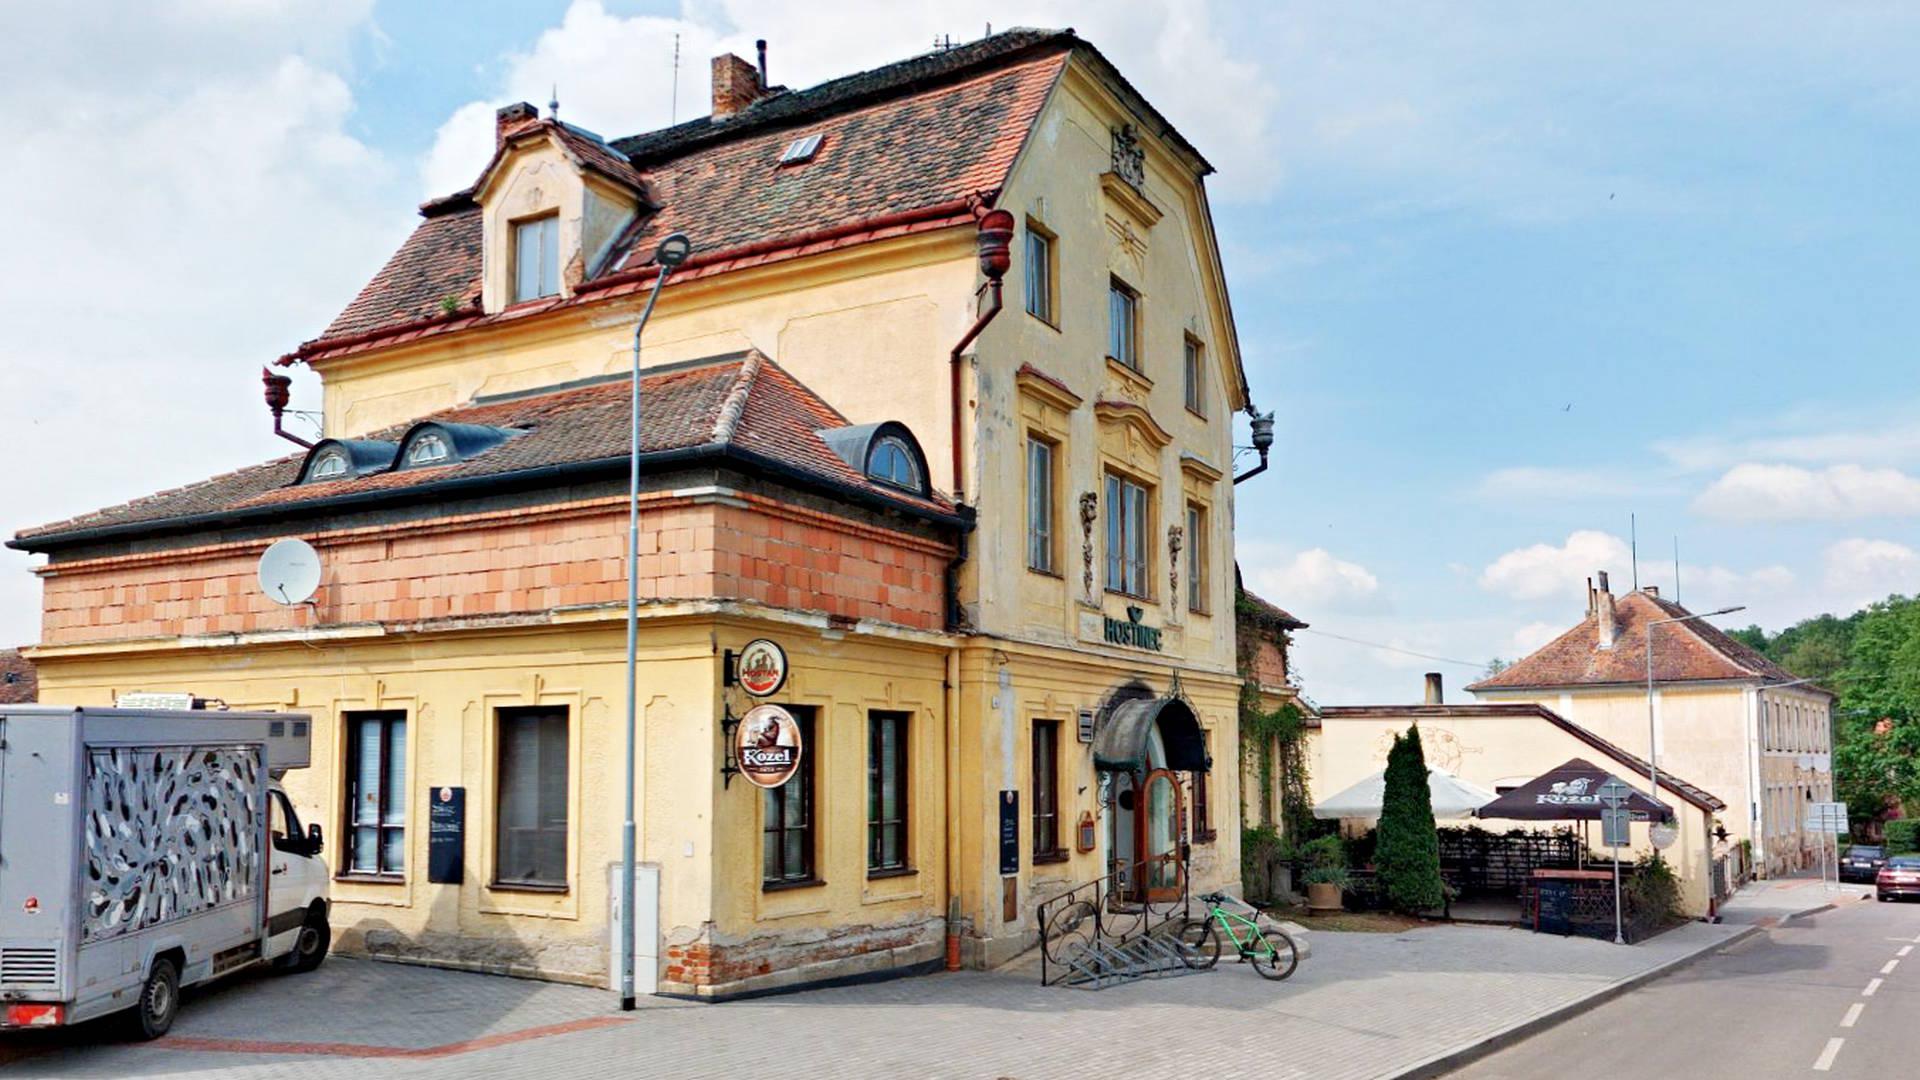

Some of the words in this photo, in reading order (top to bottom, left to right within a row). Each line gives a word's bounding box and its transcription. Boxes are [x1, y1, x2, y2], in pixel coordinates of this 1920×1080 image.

[1104, 616, 1162, 652] HOSTINEC
[743, 748, 791, 766] Kozel
[1536, 794, 1601, 805] Kozel
